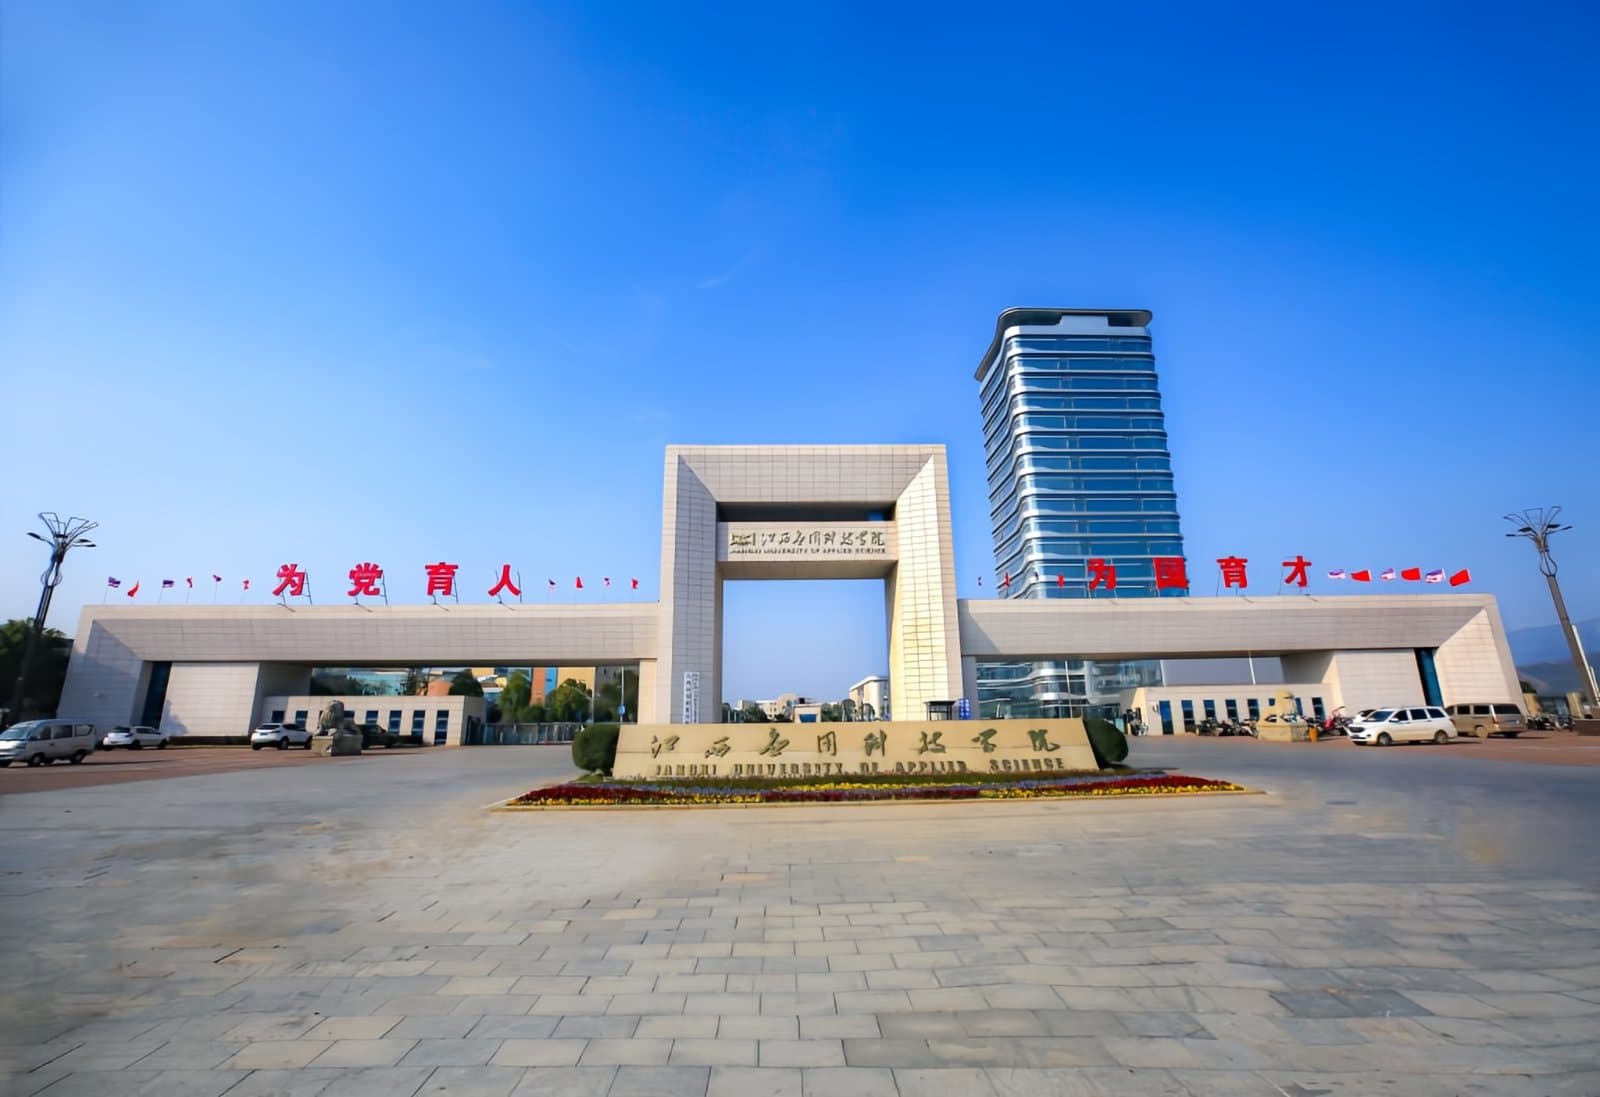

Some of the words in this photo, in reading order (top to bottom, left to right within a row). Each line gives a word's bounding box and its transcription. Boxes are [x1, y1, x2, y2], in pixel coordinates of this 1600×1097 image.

[272, 562, 521, 597] 为党育人
[1088, 555, 1312, 591] 为国育才
